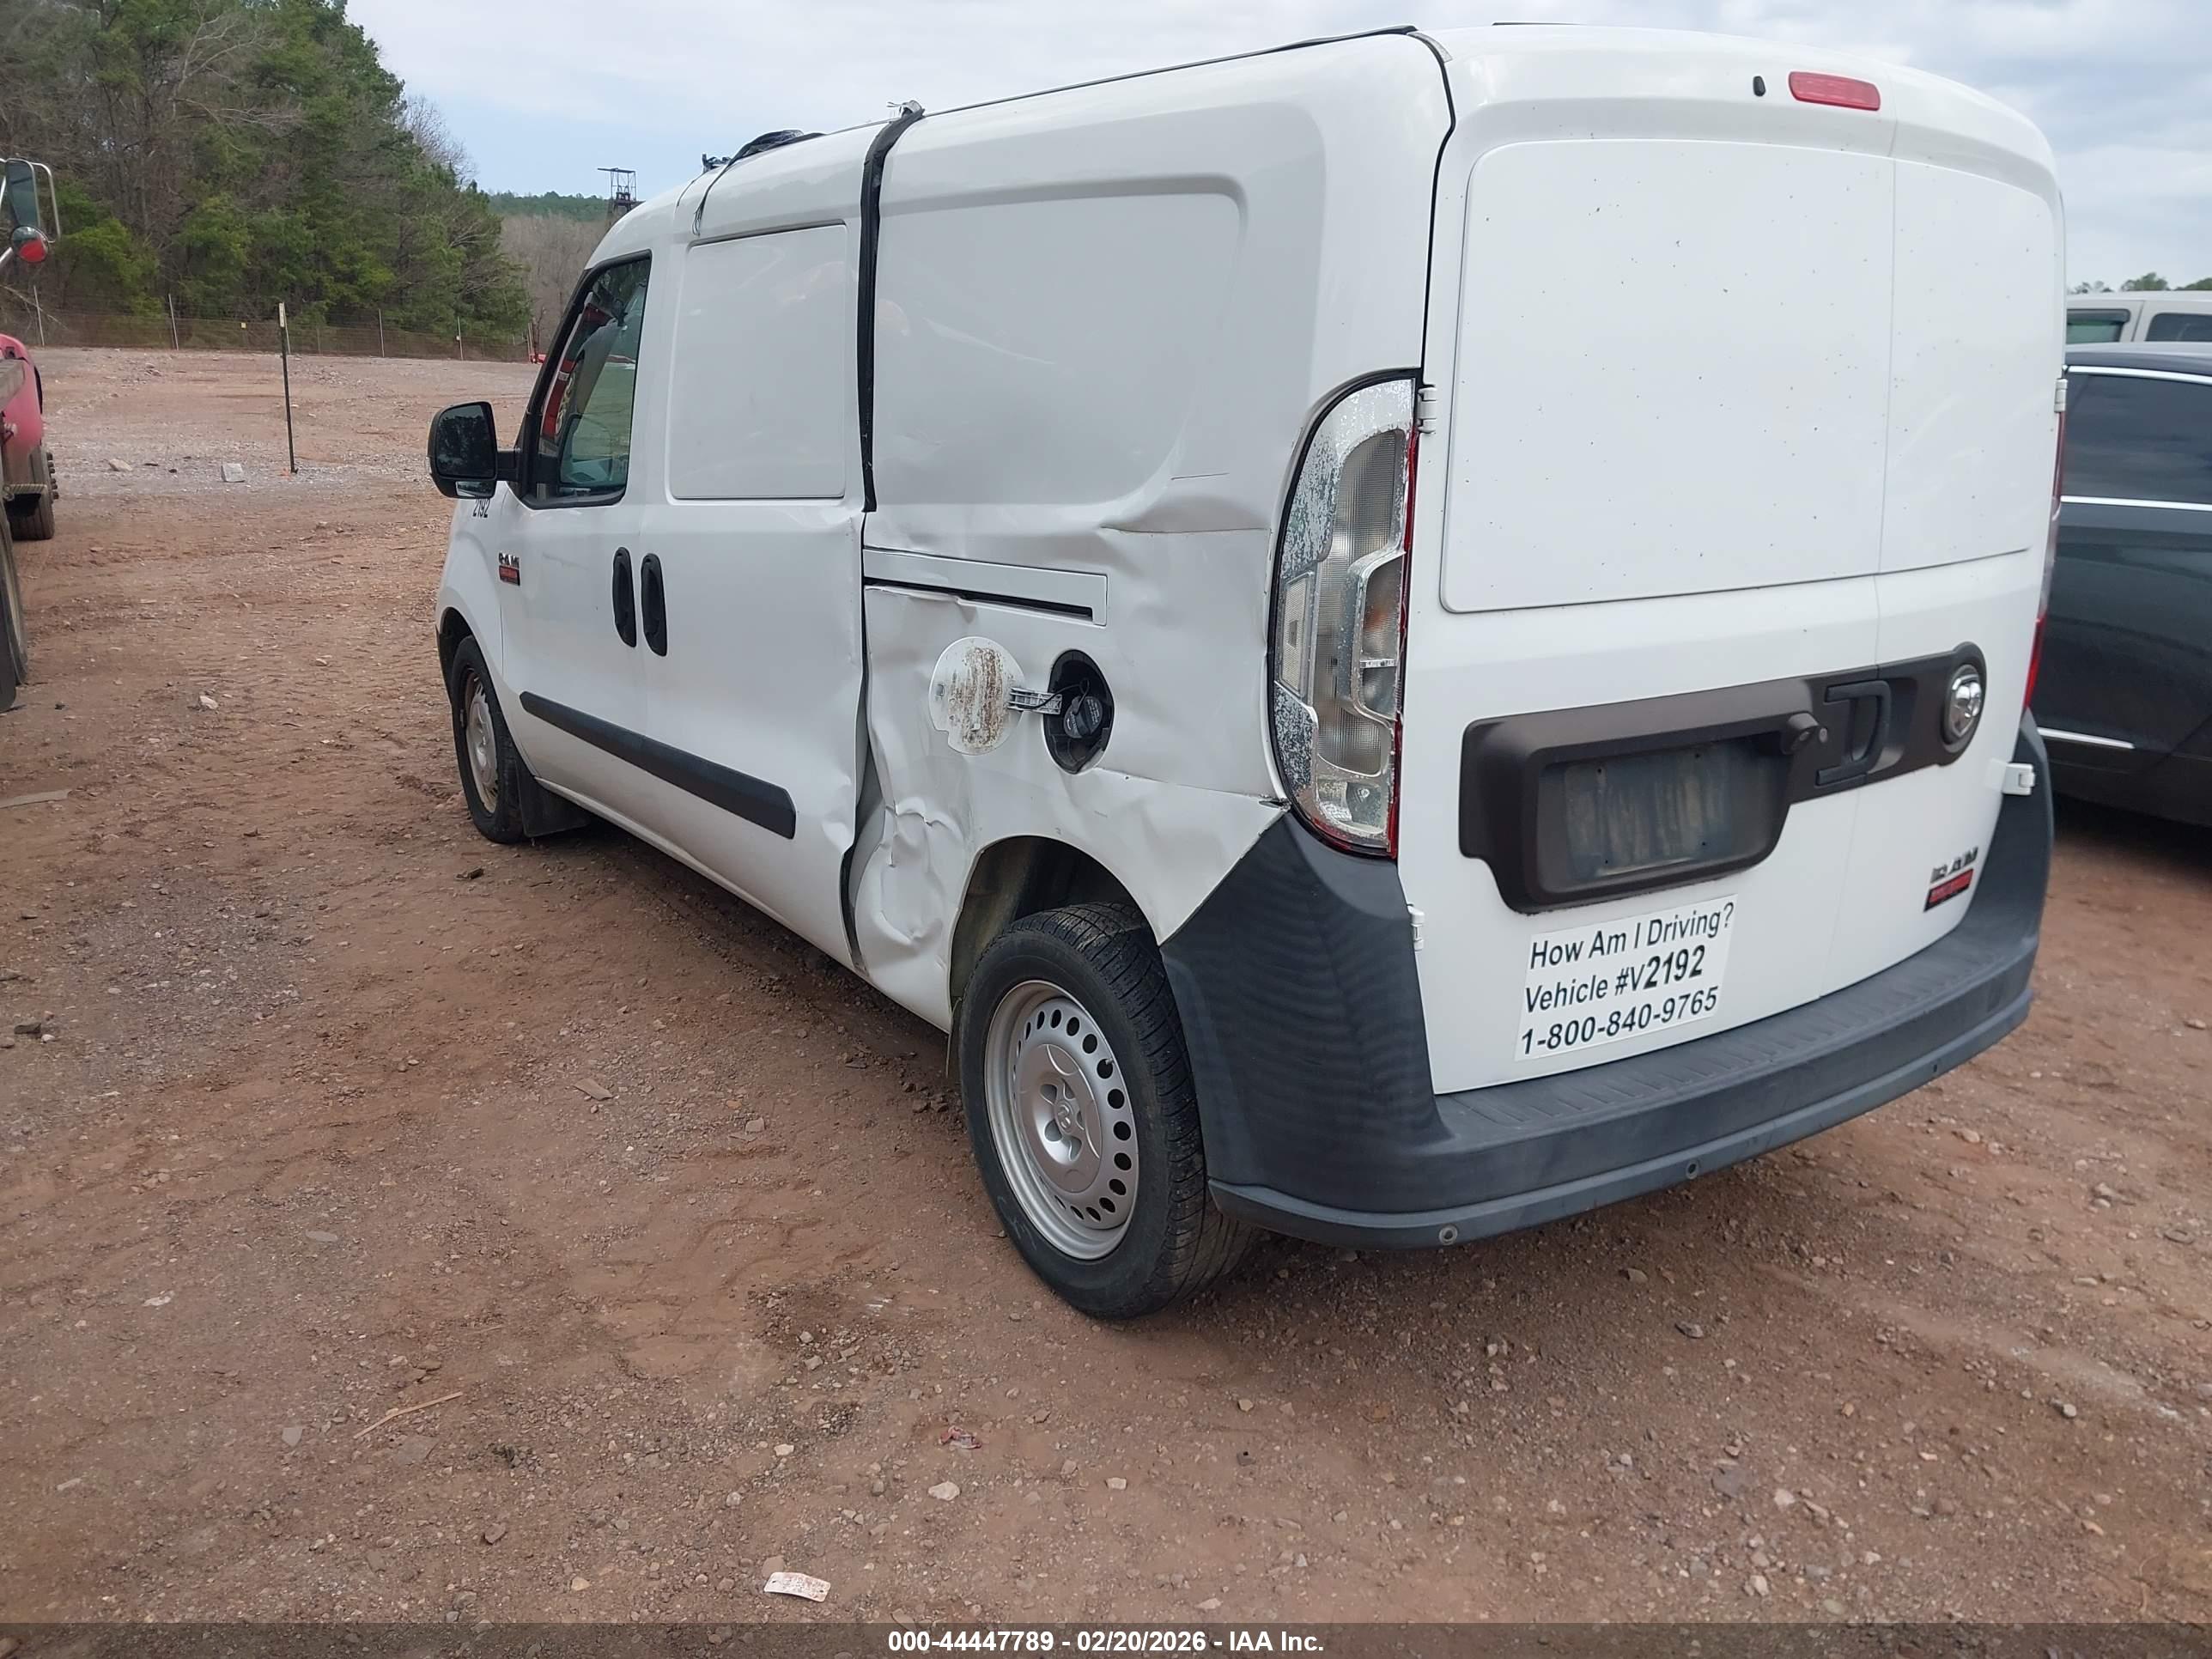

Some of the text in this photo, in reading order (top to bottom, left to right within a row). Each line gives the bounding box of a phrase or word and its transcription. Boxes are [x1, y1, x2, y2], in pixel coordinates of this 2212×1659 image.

[472, 499, 490, 518] 2192
[1930, 846, 1978, 884] RAM
[1530, 902, 1734, 969] How Am I Driving?
[1526, 945, 1705, 1012] Vehicle #V2192
[1521, 986, 1718, 1054] 1-800-840-9765
